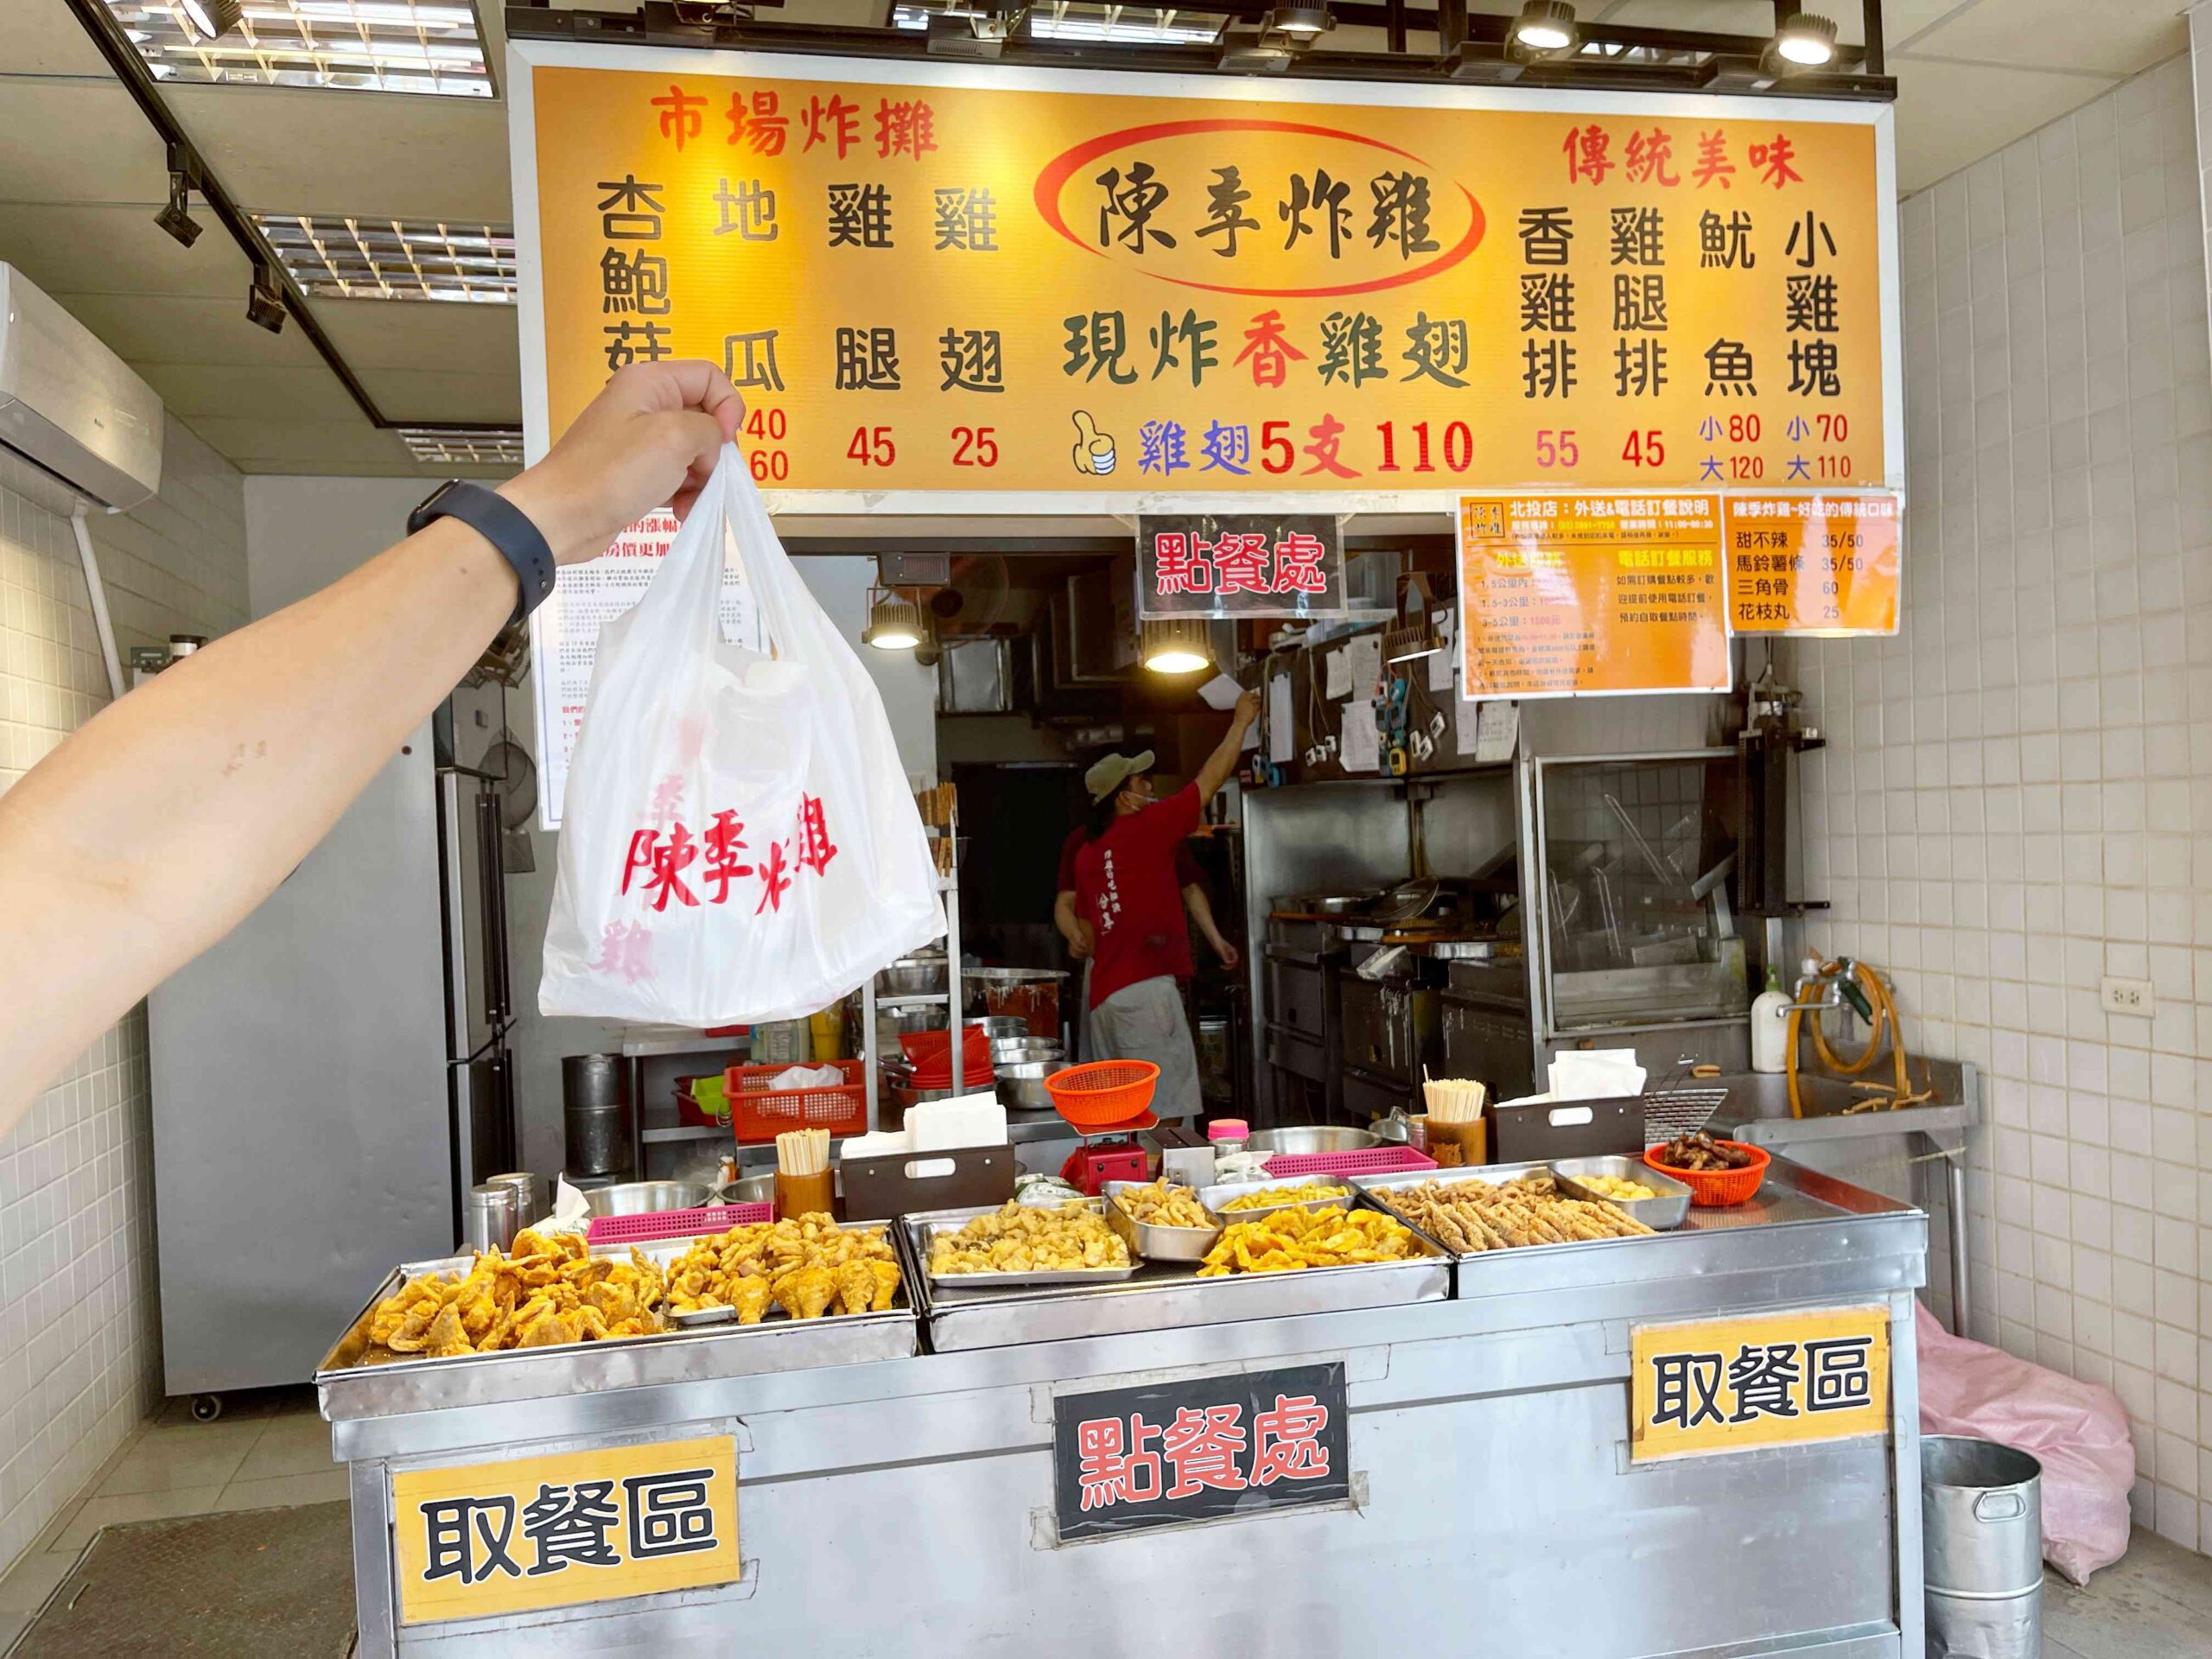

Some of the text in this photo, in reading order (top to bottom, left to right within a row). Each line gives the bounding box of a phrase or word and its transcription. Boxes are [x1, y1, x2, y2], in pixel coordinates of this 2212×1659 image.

[652, 85, 938, 162] 市場炸攤
[1562, 124, 1804, 190] 傳統美味
[1095, 162, 1441, 260] 陳季炸雞
[828, 183, 902, 391] 雞腿
[934, 187, 1006, 393] 雞翅
[1518, 207, 1578, 398] 香雞排
[1610, 207, 1669, 397] 雞腿排
[1784, 210, 1841, 397] 小雞塊
[1062, 308, 1471, 389] 現炸香雞翅
[746, 409, 787, 441] 40
[847, 426, 897, 467] 45
[950, 426, 999, 467] 25
[1536, 429, 1580, 468] 55
[1622, 429, 1666, 467] 45
[750, 450, 790, 482] 60
[1154, 531, 1327, 596] 點餐處
[1618, 550, 1713, 567] 電話訂餐服務
[1736, 531, 1864, 549] 甜不辣 35/50
[1736, 555, 1864, 573] 馬鈴薯條 35/50
[1738, 579, 1840, 596] 三角骨 60
[1738, 603, 1840, 620] 花枝丸 25
[1650, 1336, 1873, 1429] 取餐區
[1077, 1393, 1331, 1512] 點餐處
[418, 1467, 719, 1585] 取餐區
